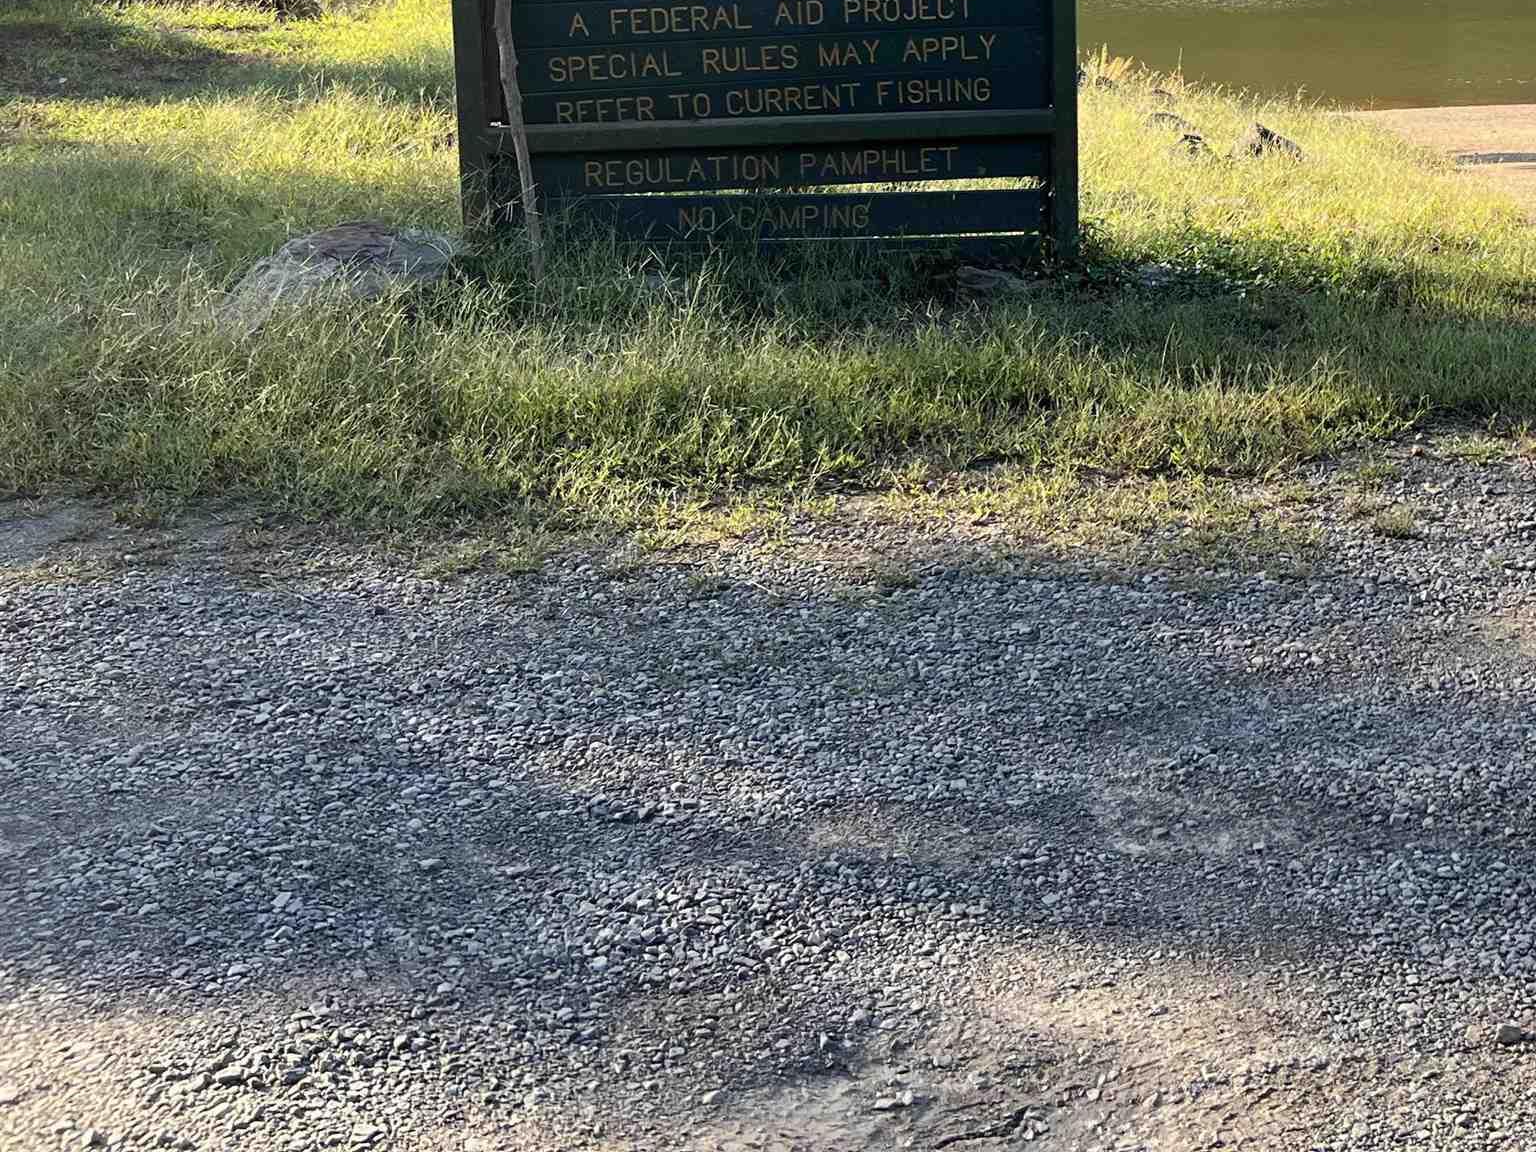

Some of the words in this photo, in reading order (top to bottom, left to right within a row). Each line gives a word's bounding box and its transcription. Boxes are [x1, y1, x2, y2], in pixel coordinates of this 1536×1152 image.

[569, 13, 590, 38] A
[610, 4, 752, 36] FEDERAL
[775, 0, 825, 27] AID
[549, 52, 683, 83] SPECIAL
[702, 45, 798, 74] RULES
[818, 40, 880, 68] MAY
[903, 34, 998, 63] APPLY
[555, 94, 656, 124] REFER
[669, 92, 712, 119] TO
[726, 82, 861, 116] CURRENT
[877, 77, 992, 106] FISHING
[584, 156, 781, 188] REGULATION
[800, 147, 959, 178] PAMPHLET
[678, 206, 717, 232] NO
[737, 204, 871, 231] CAMPING
